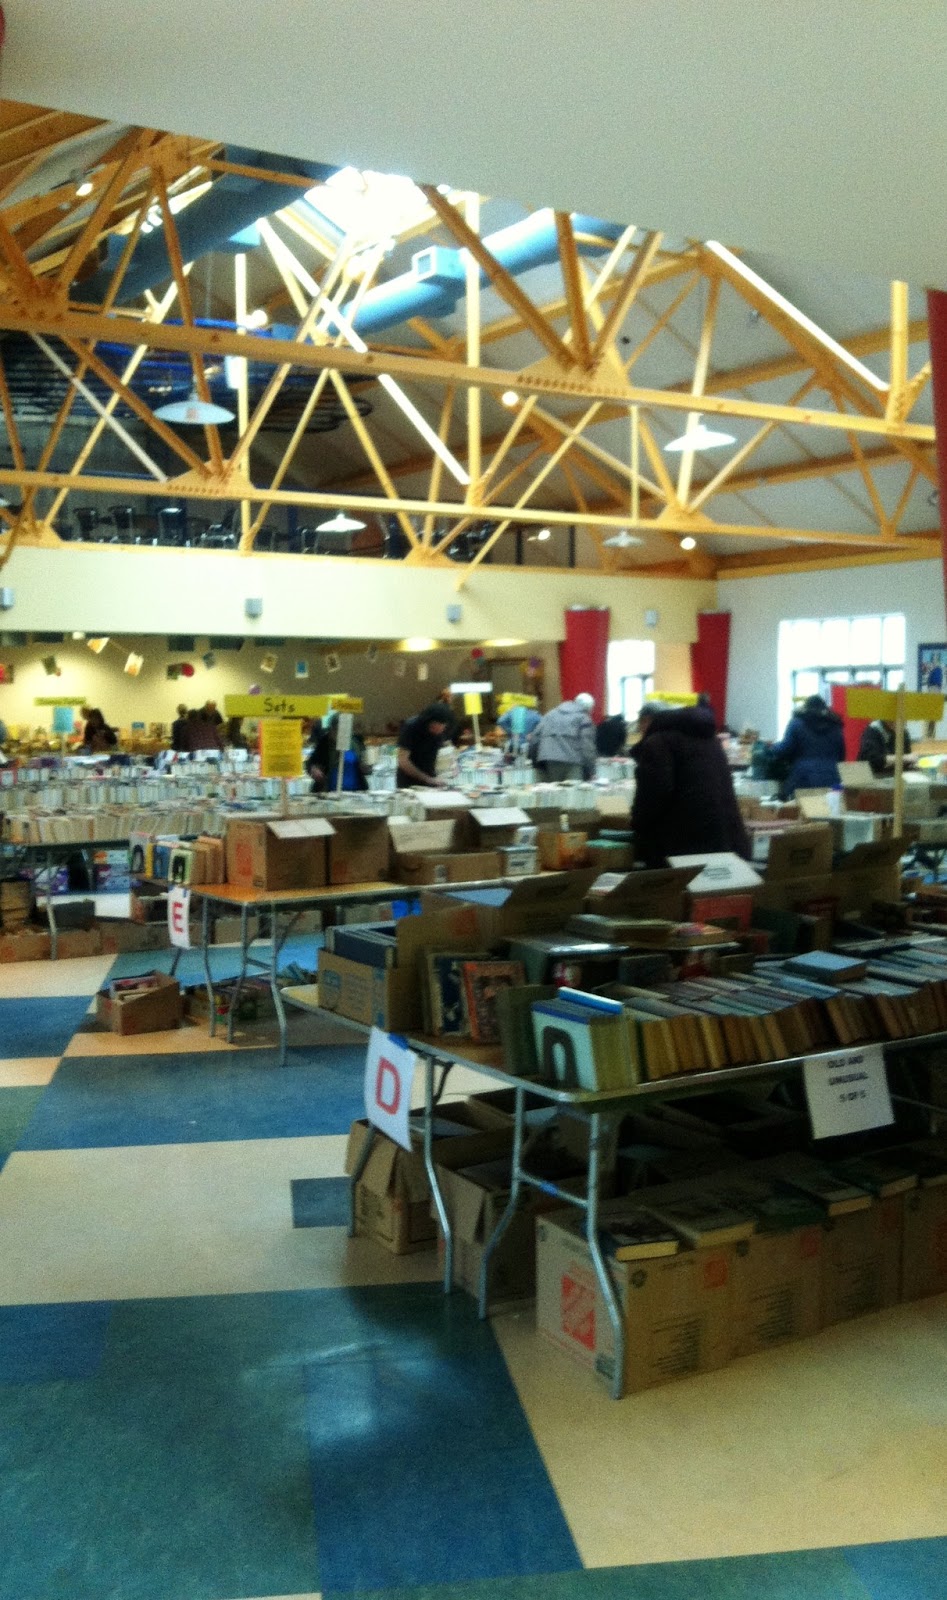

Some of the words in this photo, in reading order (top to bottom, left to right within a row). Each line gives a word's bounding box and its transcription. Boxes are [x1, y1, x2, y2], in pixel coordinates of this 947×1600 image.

[263, 697, 296, 713] Sets
[172, 901, 184, 933] E
[375, 1056, 402, 1115] D
